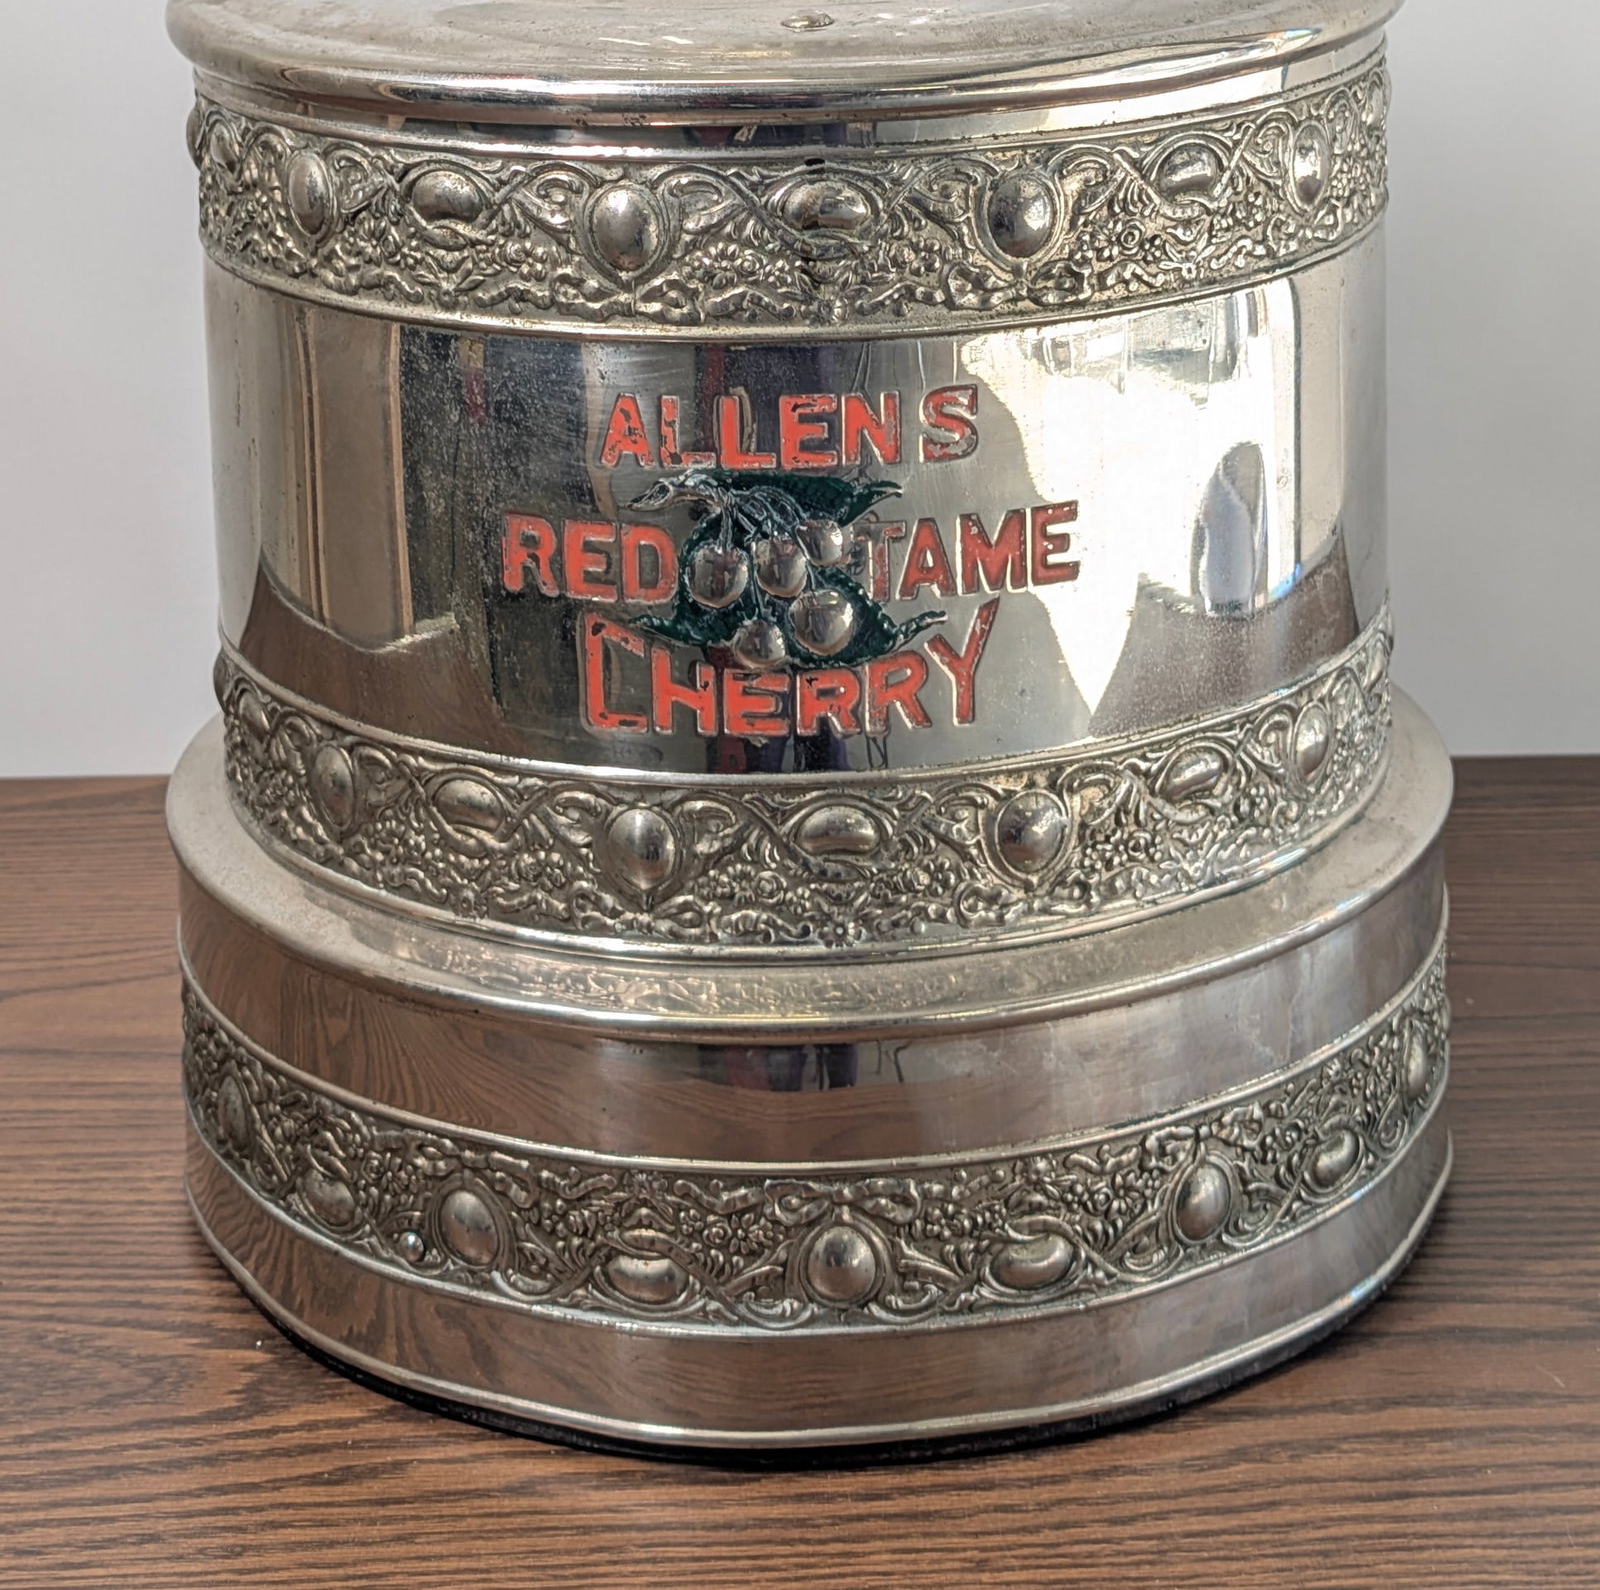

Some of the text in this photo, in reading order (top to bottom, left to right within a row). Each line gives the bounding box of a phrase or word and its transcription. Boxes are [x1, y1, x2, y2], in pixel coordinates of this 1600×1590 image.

[602, 384, 979, 469] ALLENS
[501, 500, 1080, 603] RED TAME
[579, 598, 1000, 738] CHERRY
